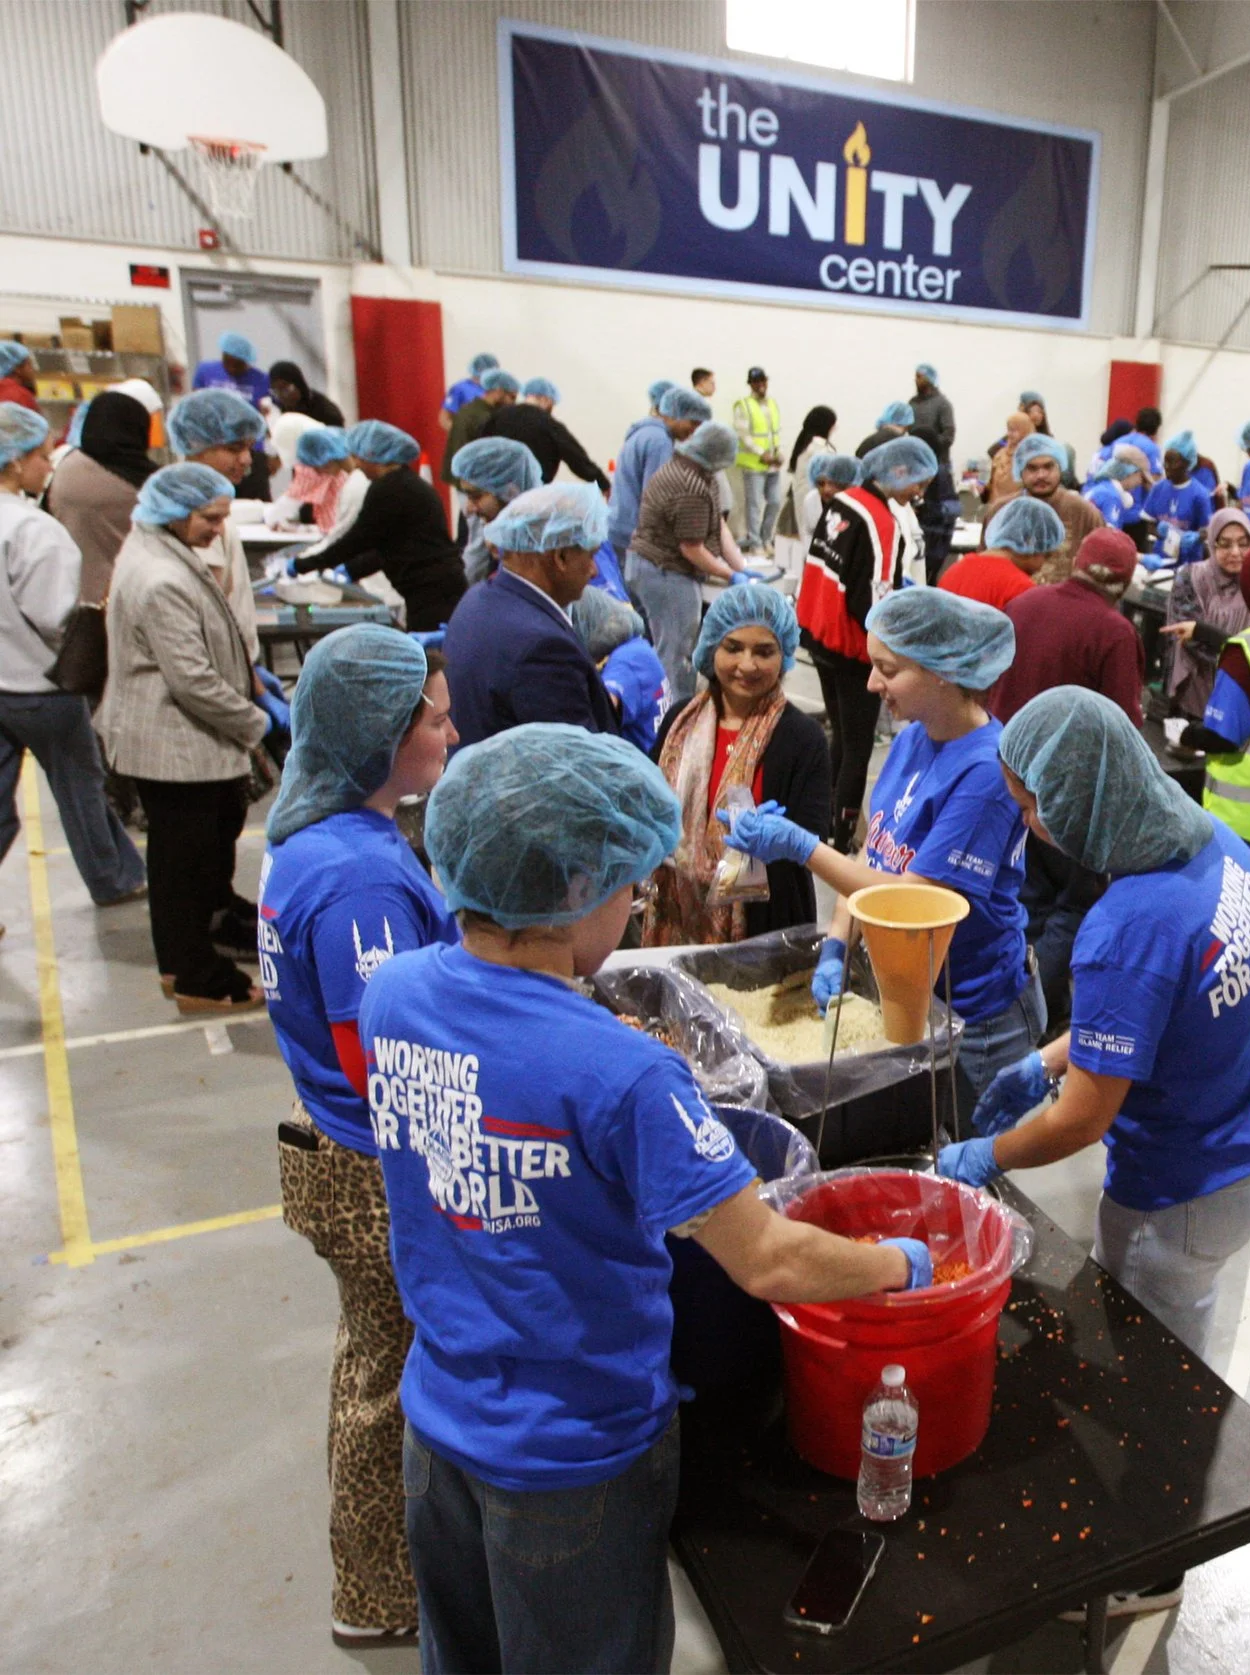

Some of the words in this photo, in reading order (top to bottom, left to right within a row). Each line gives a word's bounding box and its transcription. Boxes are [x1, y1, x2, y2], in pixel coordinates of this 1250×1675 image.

[697, 83, 780, 146] the
[818, 253, 961, 302] center
[1209, 855, 1245, 945] WORKING
[373, 1036, 480, 1093] WORKING
[1094, 1032, 1115, 1043] TEAM
[1105, 1043, 1134, 1055] RELIEF
[368, 1072, 484, 1138] OGETHER
[450, 1122, 573, 1180] BETTER
[428, 1158, 540, 1219] WORLD
